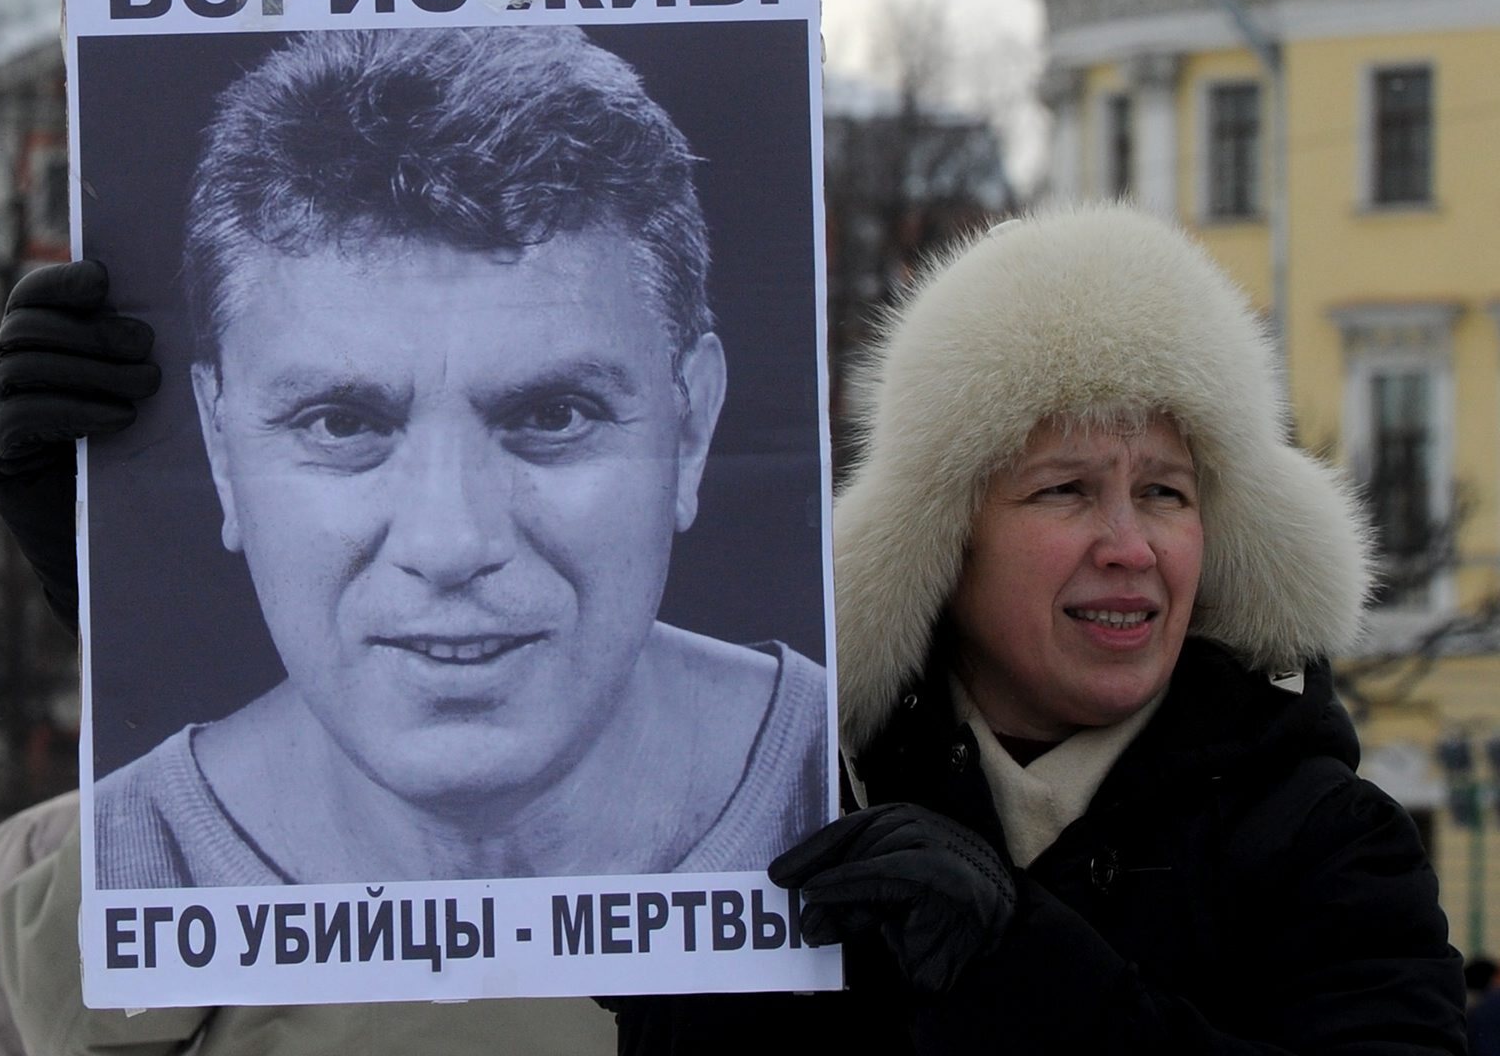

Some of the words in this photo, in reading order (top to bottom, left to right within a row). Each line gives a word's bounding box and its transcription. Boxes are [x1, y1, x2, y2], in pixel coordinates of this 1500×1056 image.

[106, 905, 218, 969] ЕГО
[236, 886, 496, 972] УБИЙЦЫ
[552, 889, 820, 956] МЕРТВЫ
